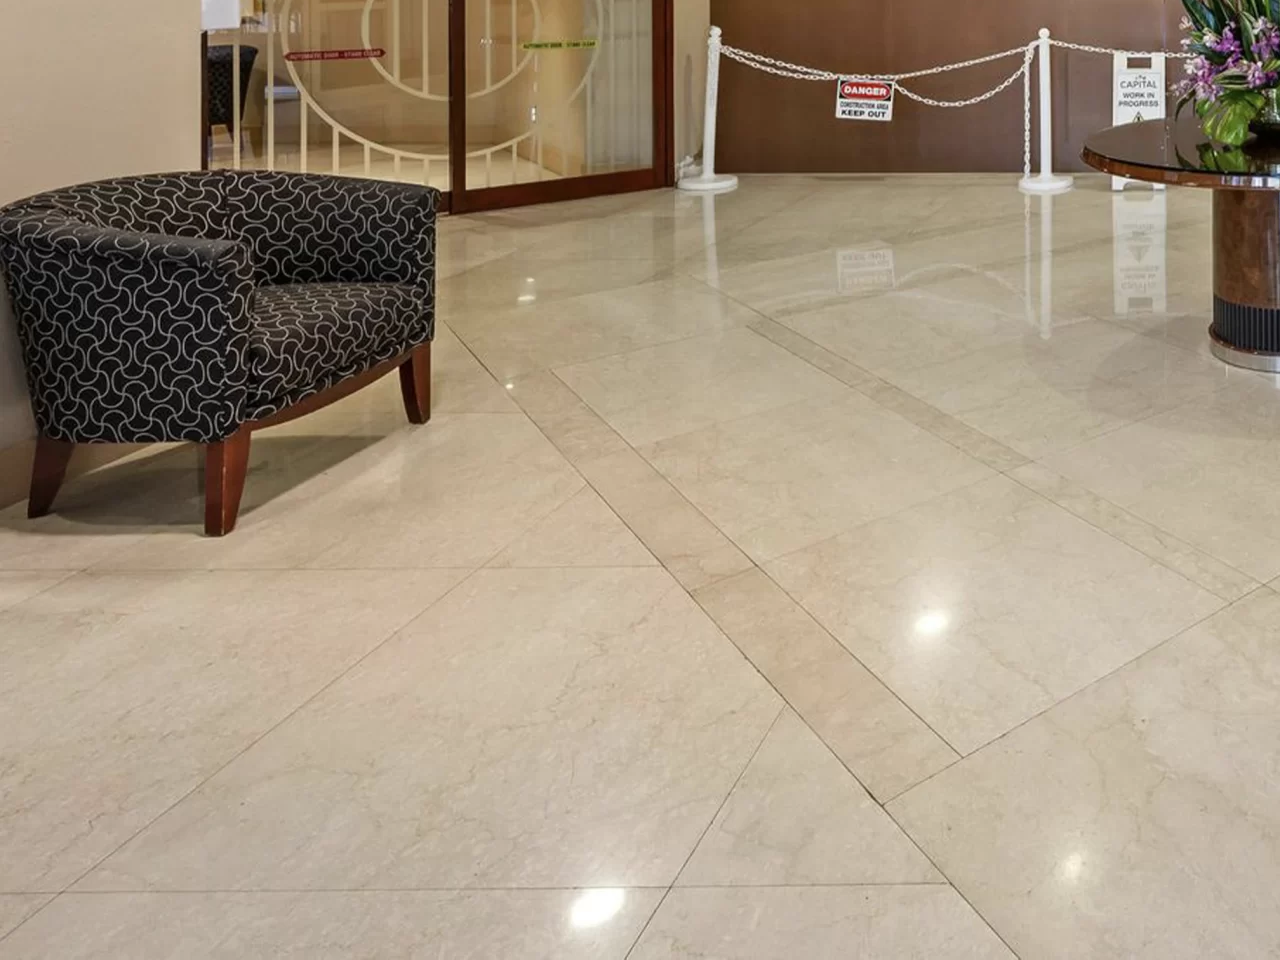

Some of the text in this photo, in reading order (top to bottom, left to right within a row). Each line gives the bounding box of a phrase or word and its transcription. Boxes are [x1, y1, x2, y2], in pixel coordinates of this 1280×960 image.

[1120, 80, 1157, 89] CAPITAL
[844, 85, 887, 96] DANGER
[841, 109, 886, 118] KEEP OUT
